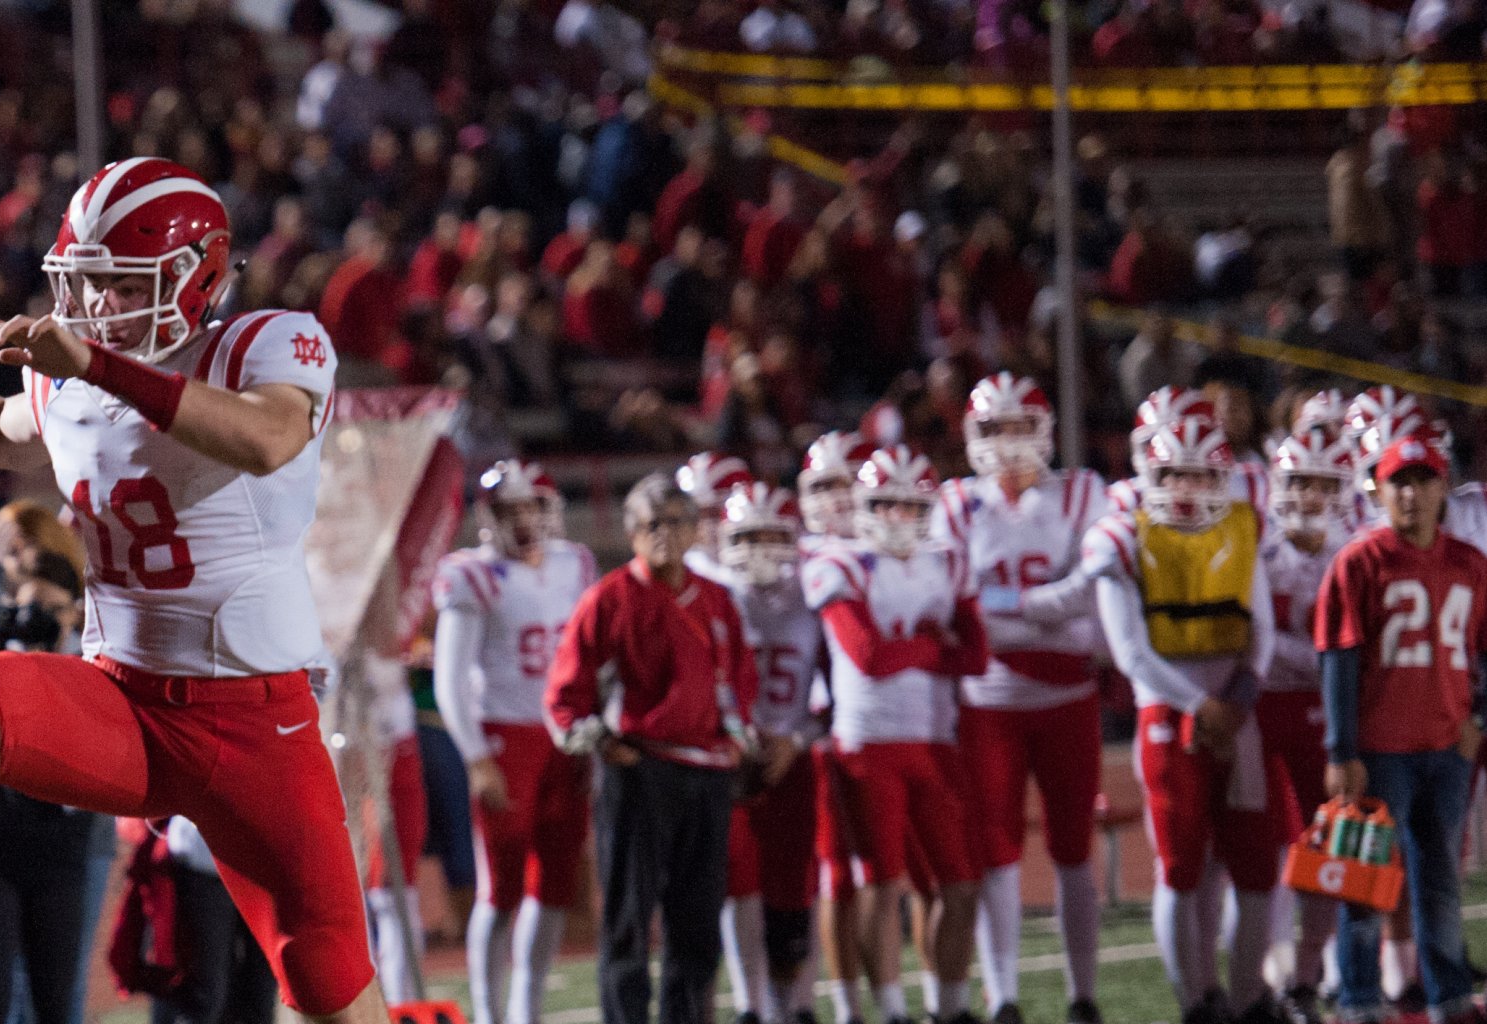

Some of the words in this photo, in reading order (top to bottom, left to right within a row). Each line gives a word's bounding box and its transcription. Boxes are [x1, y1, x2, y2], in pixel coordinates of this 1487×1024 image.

[72, 475, 196, 590] 18
[1381, 578, 1473, 670] 24
[1317, 859, 1347, 893] G
